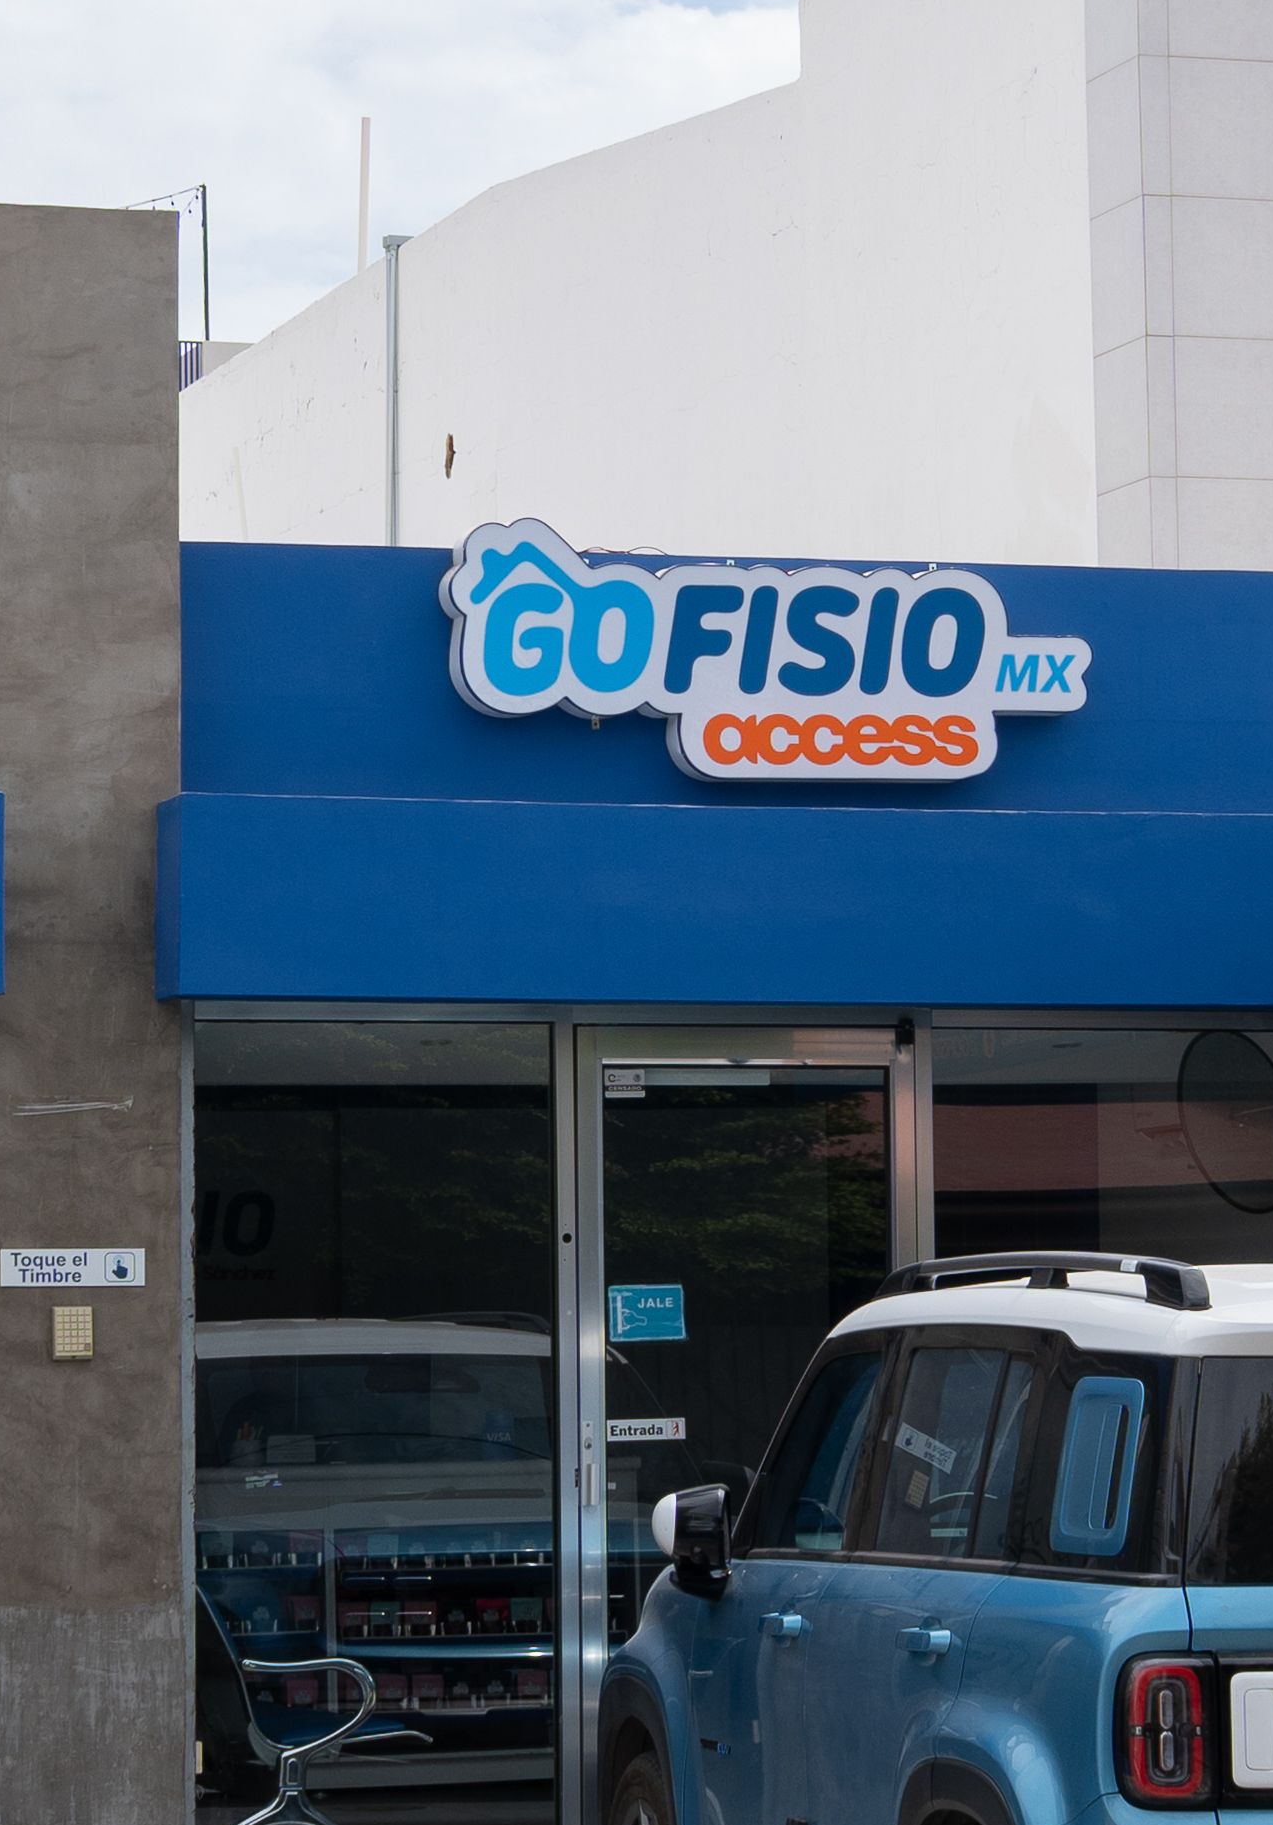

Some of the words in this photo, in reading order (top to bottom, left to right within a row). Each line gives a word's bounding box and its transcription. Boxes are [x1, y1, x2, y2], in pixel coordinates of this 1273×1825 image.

[995, 654, 1075, 694] MX
[703, 713, 979, 766] access
[10, 1252, 67, 1270] Toque
[72, 1252, 87, 1266] el
[18, 1269, 82, 1283] Timbre
[637, 1297, 674, 1308] JALE
[610, 1425, 663, 1436] Entrada
